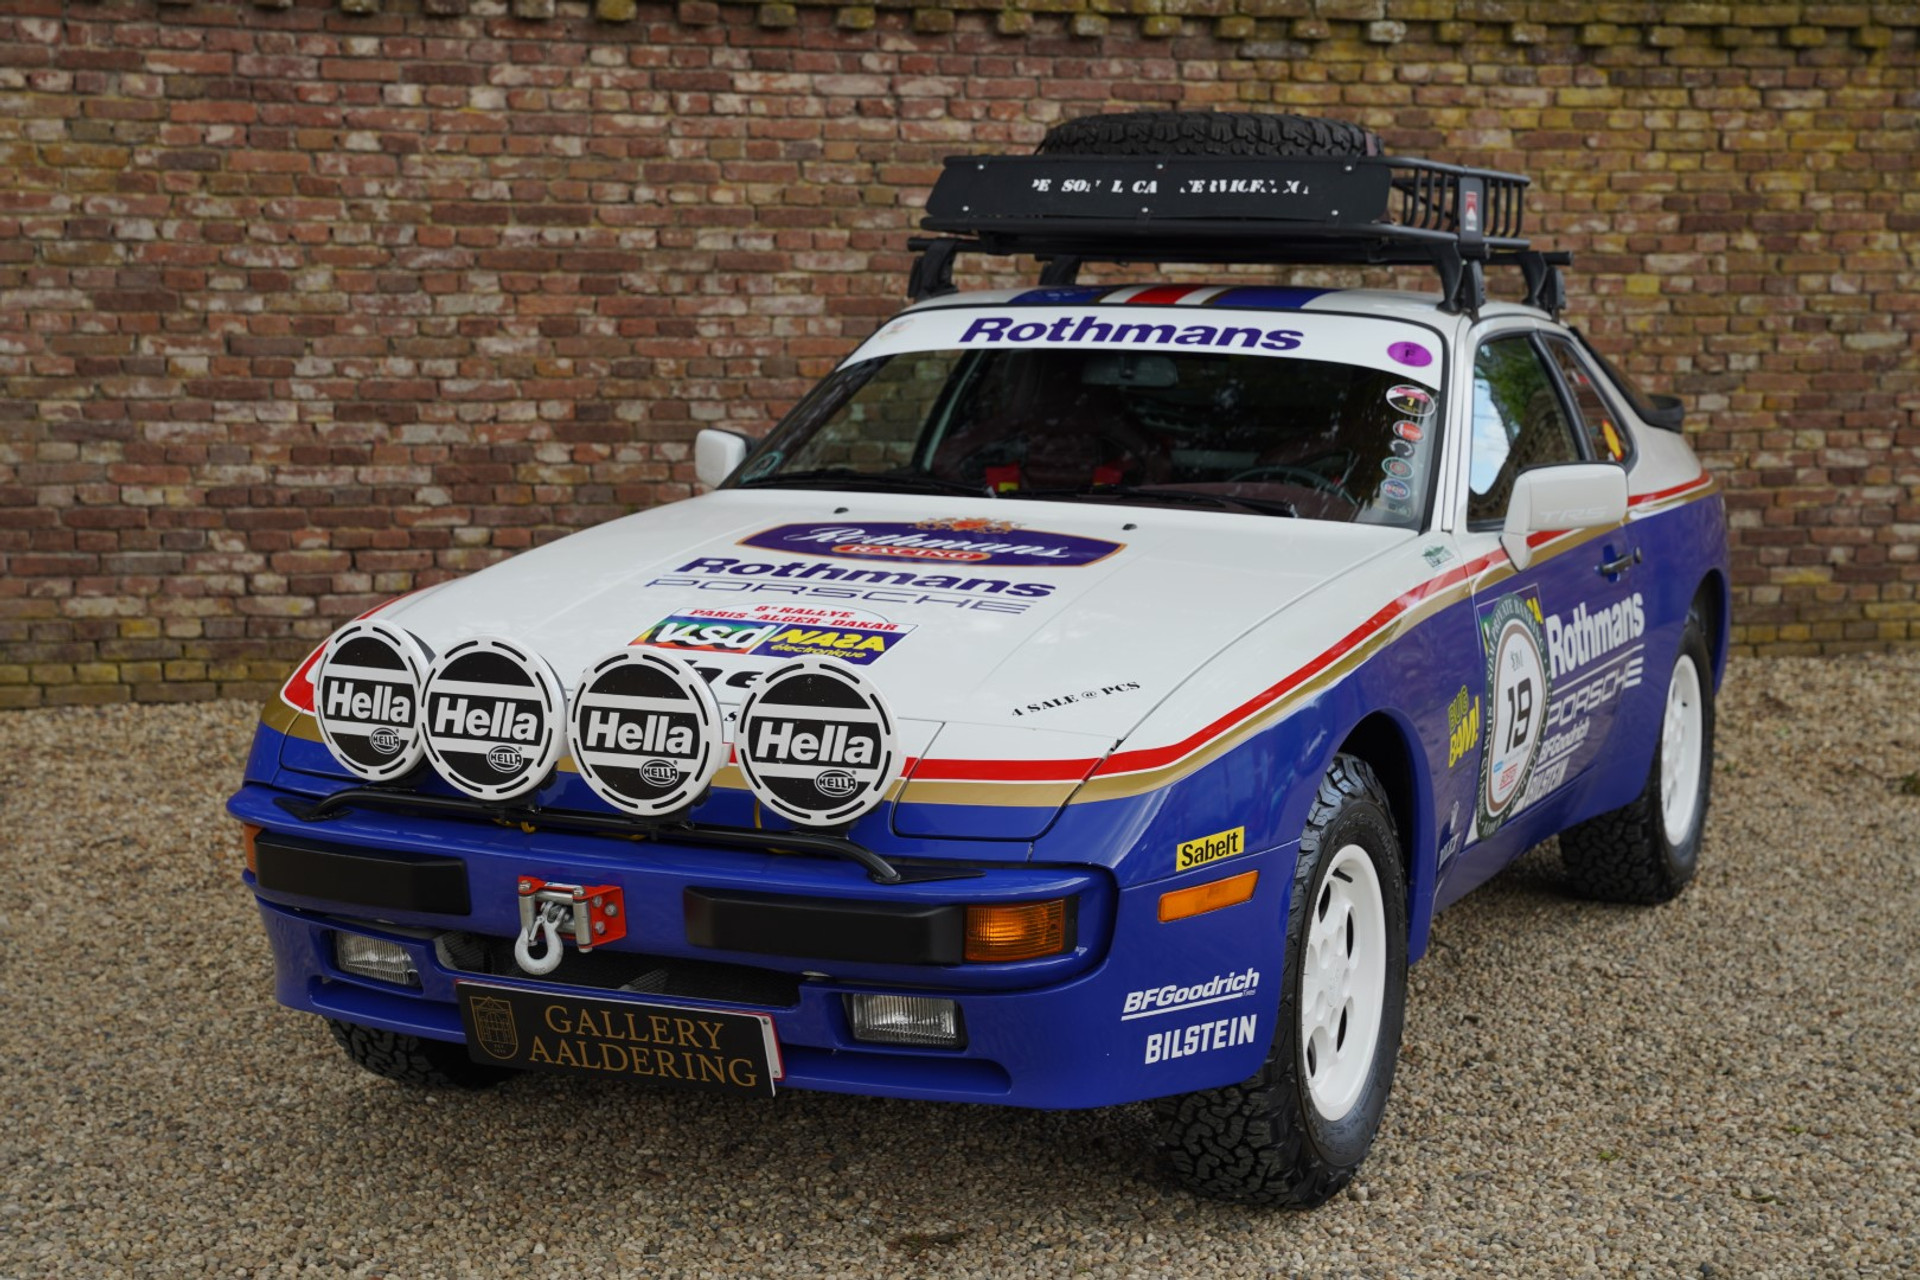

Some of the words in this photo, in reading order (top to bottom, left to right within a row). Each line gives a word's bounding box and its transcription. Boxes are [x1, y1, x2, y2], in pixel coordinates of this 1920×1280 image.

[1131, 180, 1159, 194] CA
[958, 316, 1305, 350] Rothmans
[783, 526, 1070, 559] Rothmans
[849, 545, 975, 561] RACING
[644, 578, 1036, 614] PORSCHE
[674, 557, 1056, 598] Rothmans
[778, 606, 856, 618] RALLYE
[1545, 592, 1645, 679] Rothmans
[326, 680, 412, 724] Hella
[1026, 694, 1079, 713] SALE
[1081, 691, 1098, 699] @
[1100, 681, 1141, 696] PCS
[1505, 677, 1533, 754] 19
[1543, 656, 1644, 735] PORSCHE
[433, 696, 539, 742] Hella
[585, 710, 694, 755] Hella
[1448, 696, 1480, 769] BAM!
[372, 735, 401, 748] HELLA
[489, 753, 523, 766] HELLA
[755, 721, 875, 765] Hella
[641, 765, 679, 780] HELLA
[818, 775, 857, 790] HELLA
[1181, 832, 1239, 867] Sabelt
[1122, 967, 1260, 1014] BFGoodrich
[544, 1005, 724, 1051] GALLERY
[1144, 1014, 1257, 1065] BILSTEIN
[528, 1035, 758, 1087] AALDERING
